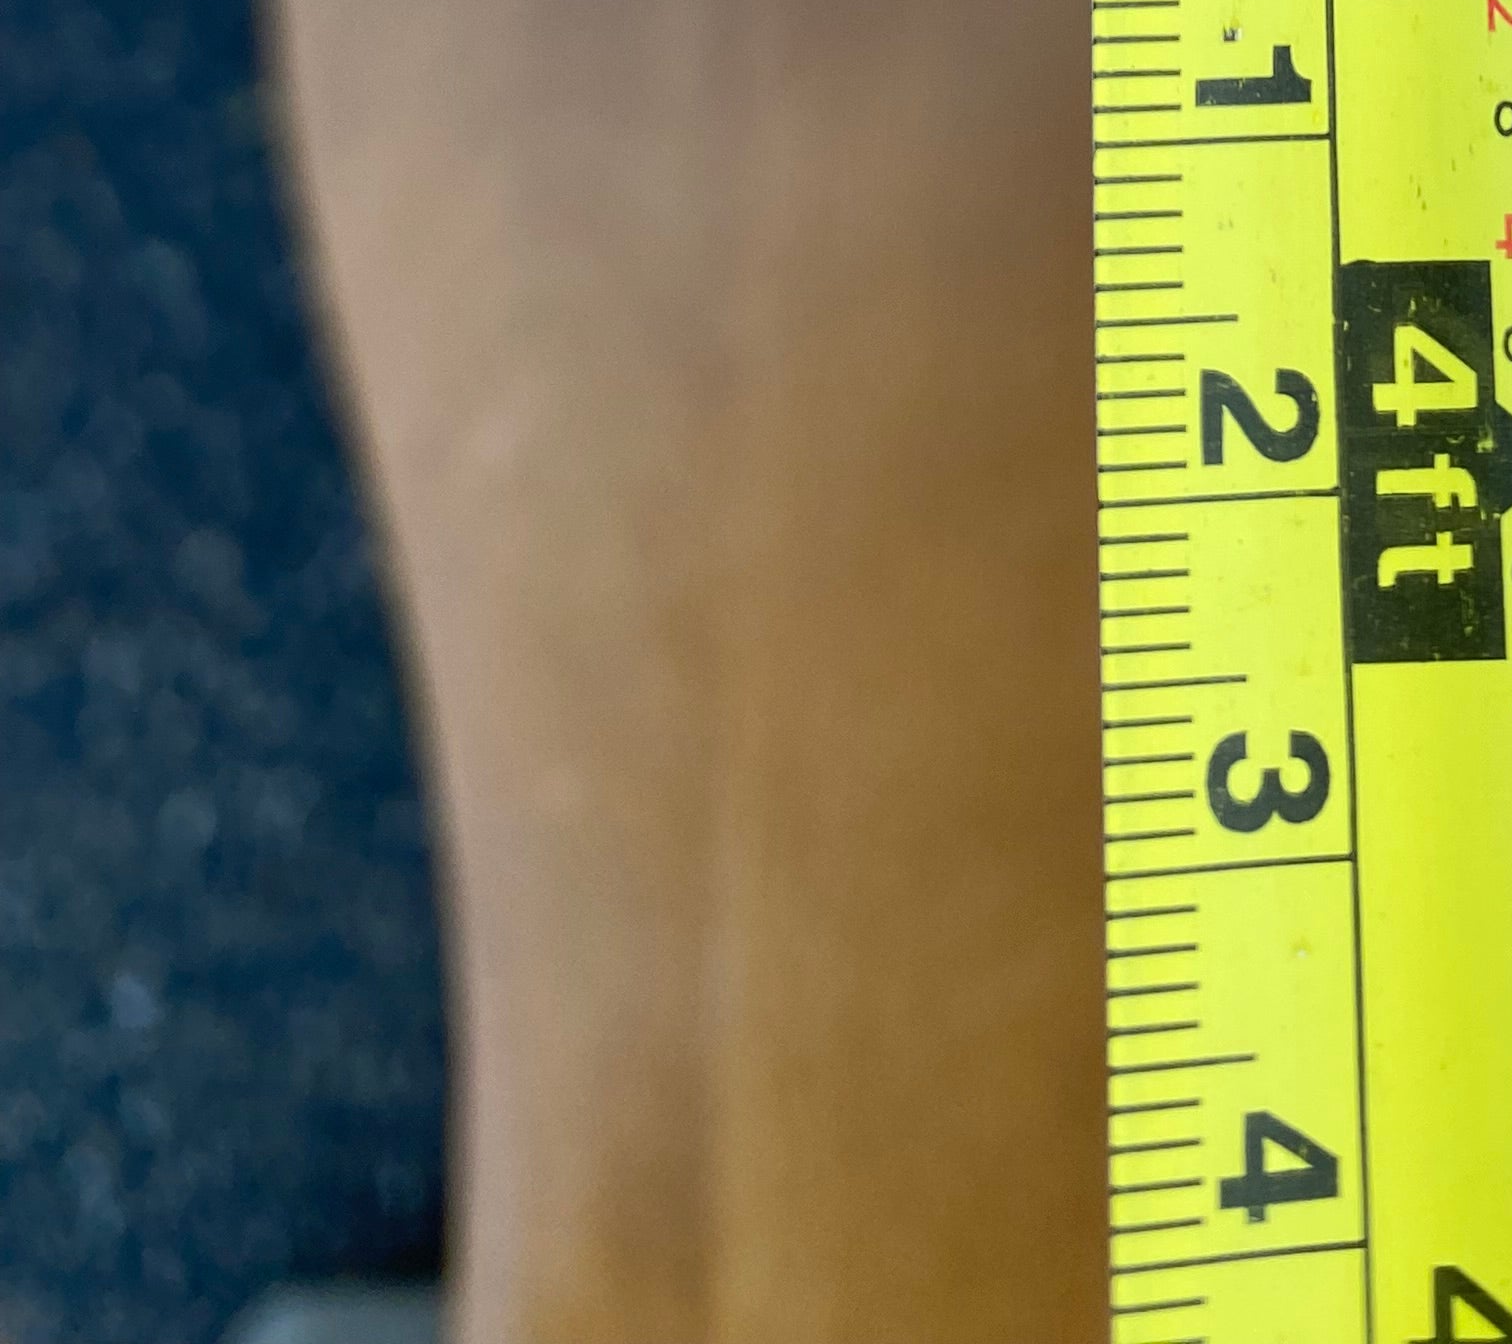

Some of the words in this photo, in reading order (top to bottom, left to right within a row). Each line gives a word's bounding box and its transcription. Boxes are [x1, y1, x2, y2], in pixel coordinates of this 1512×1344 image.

[1195, 44, 1312, 108] 1
[1200, 368, 1321, 466] 2
[1372, 321, 1479, 589] 4ft
[1204, 730, 1332, 834] 3
[1217, 1110, 1341, 1225] 4
